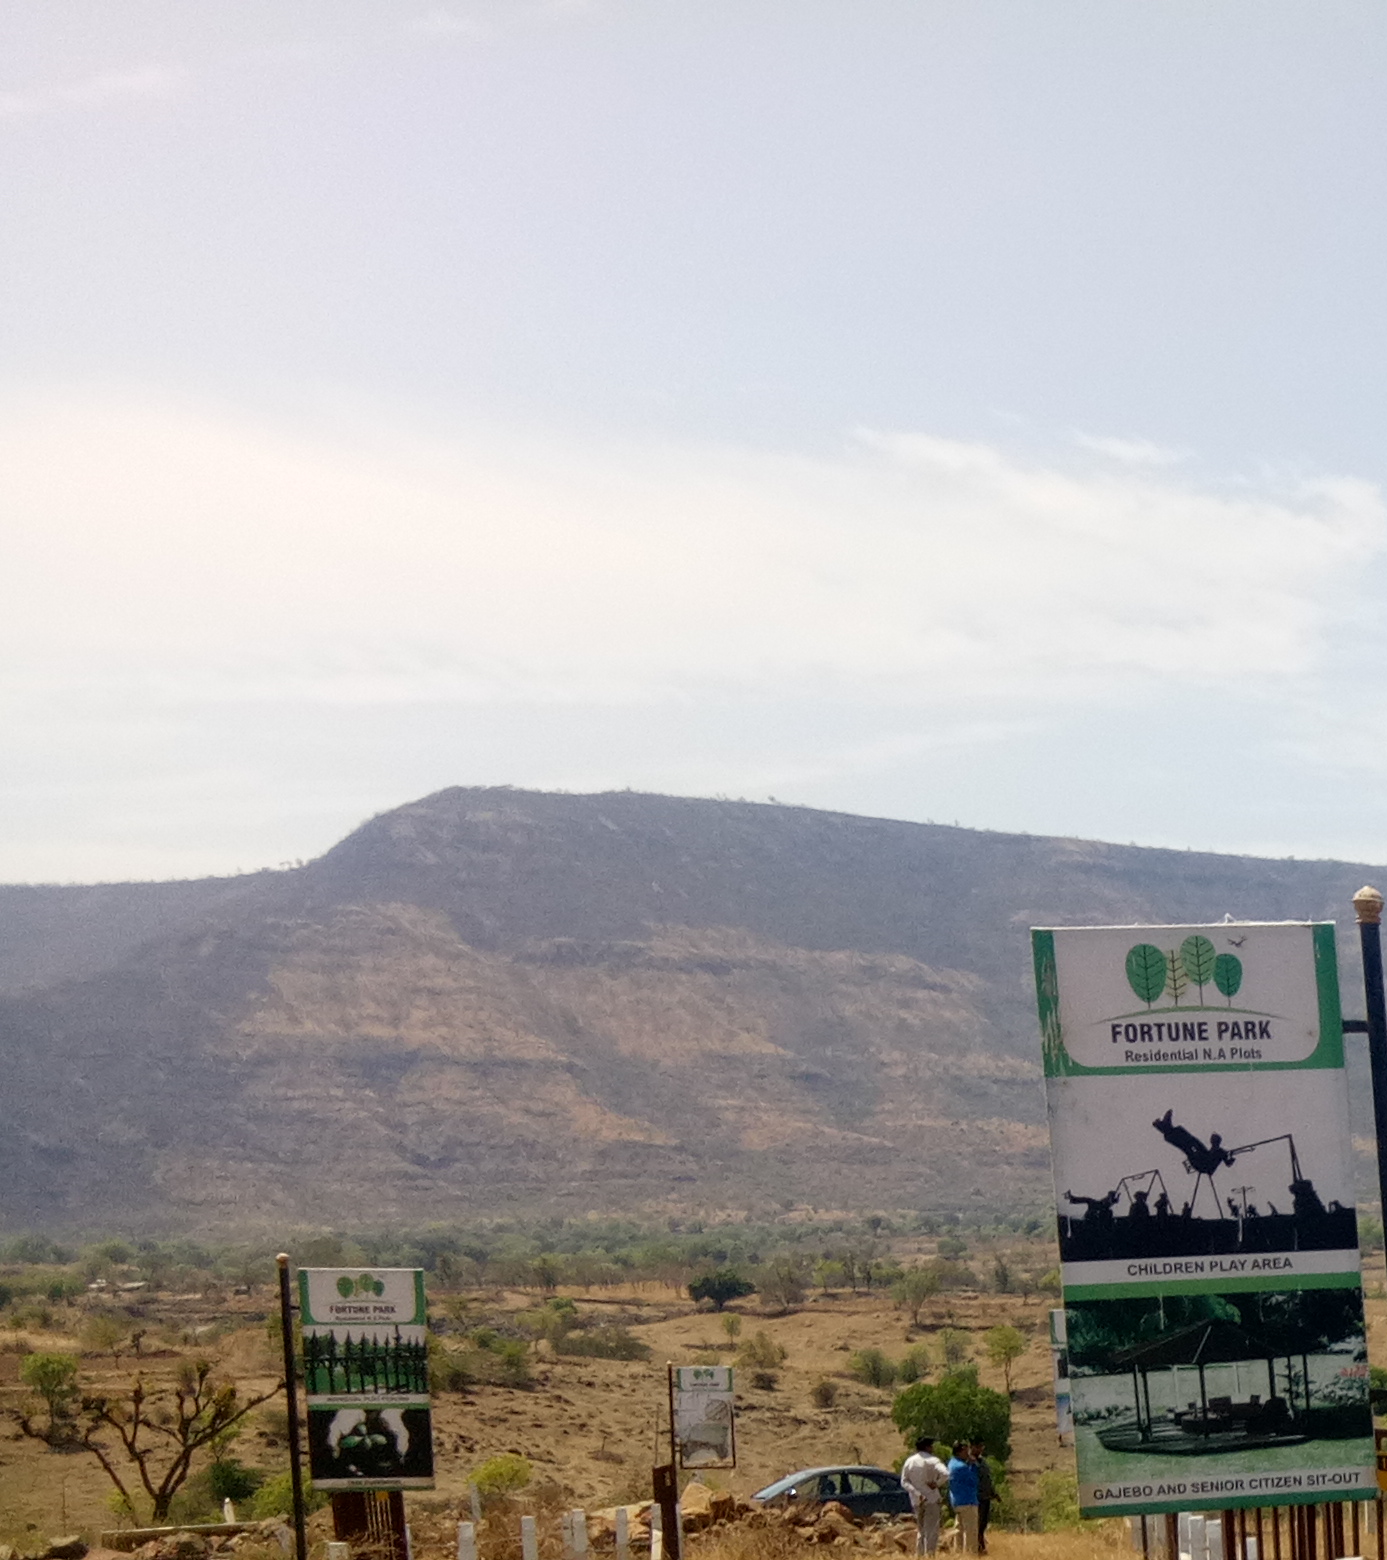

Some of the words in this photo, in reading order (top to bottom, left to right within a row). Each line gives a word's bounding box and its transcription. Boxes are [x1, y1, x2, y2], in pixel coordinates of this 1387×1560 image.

[1110, 1022, 1210, 1044] FORTUNE
[1217, 1020, 1272, 1041] PARK
[1125, 1049, 1199, 1063] Residential
[1231, 1047, 1263, 1060] Plots
[1127, 1261, 1205, 1276] CHILDREN
[1209, 1259, 1248, 1272] PLAY
[1250, 1257, 1293, 1270] AREA
[1092, 1484, 1153, 1501] GAJEBO
[1157, 1483, 1187, 1496] AND
[1190, 1480, 1245, 1494] SENIOR
[1248, 1476, 1303, 1490] CITIZEN
[1306, 1472, 1362, 1486] SIT-OUT
